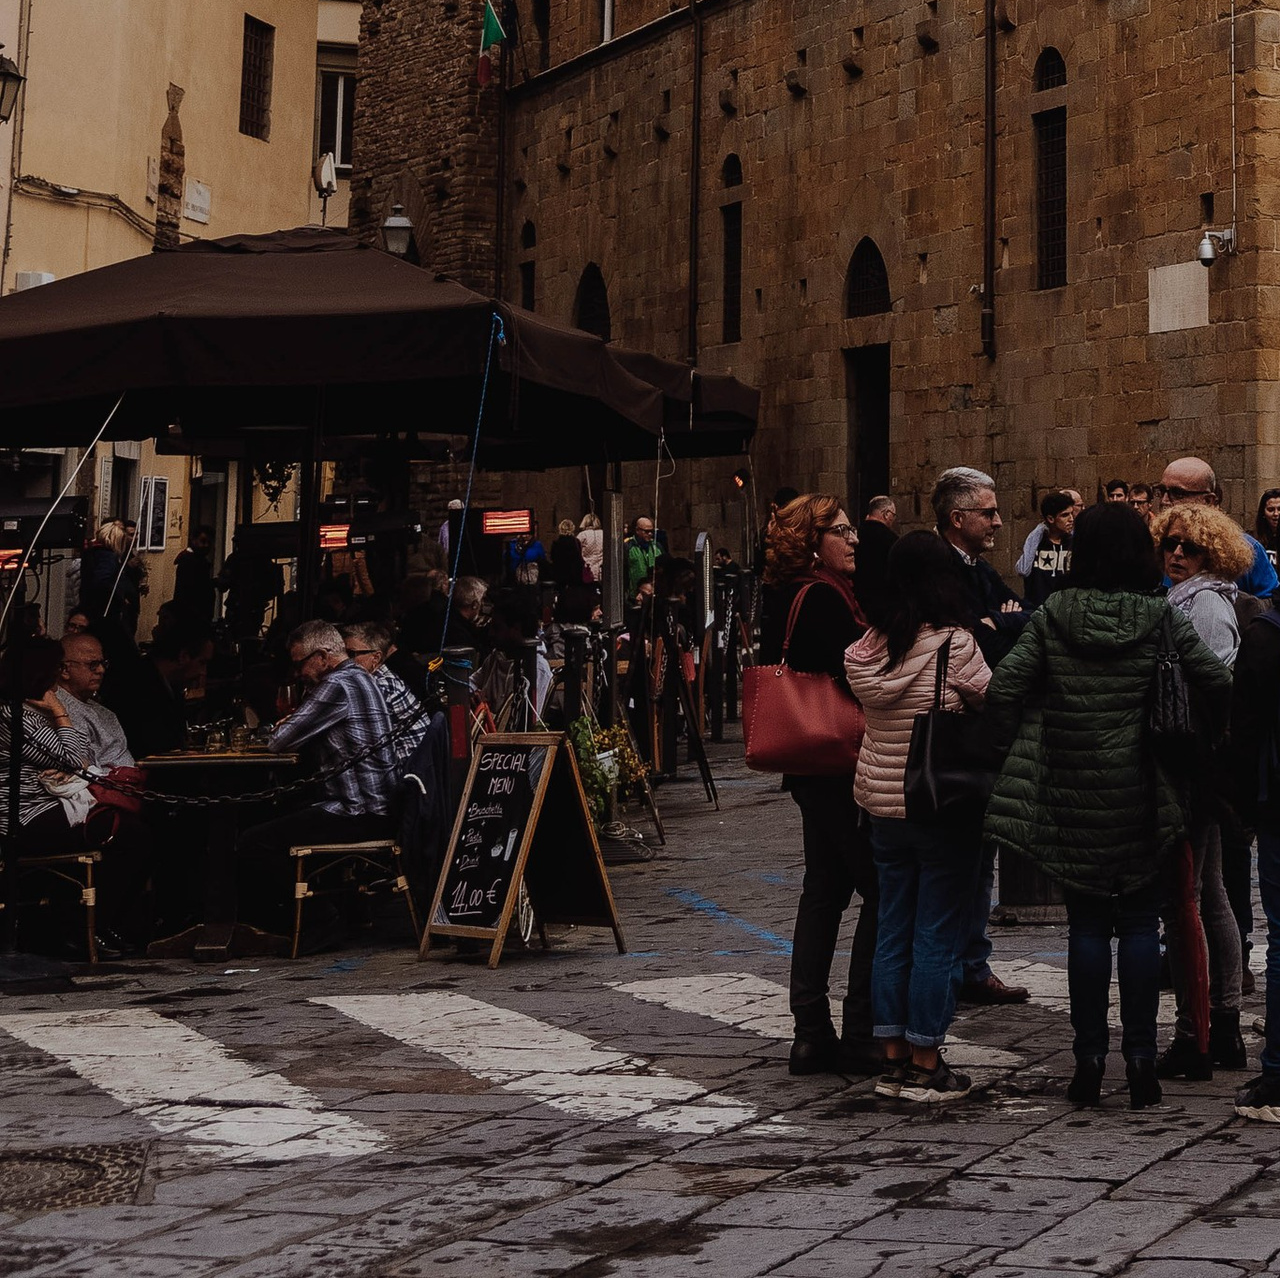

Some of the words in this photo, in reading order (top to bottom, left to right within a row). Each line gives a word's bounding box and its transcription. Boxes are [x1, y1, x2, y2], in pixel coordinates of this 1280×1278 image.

[479, 751, 527, 772] SPECIAL
[487, 776, 516, 795] MENU
[469, 802, 503, 817] Bruschetta
[466, 828, 483, 844] Pasta
[451, 880, 483, 913] 14,00
[486, 878, 502, 905] €
